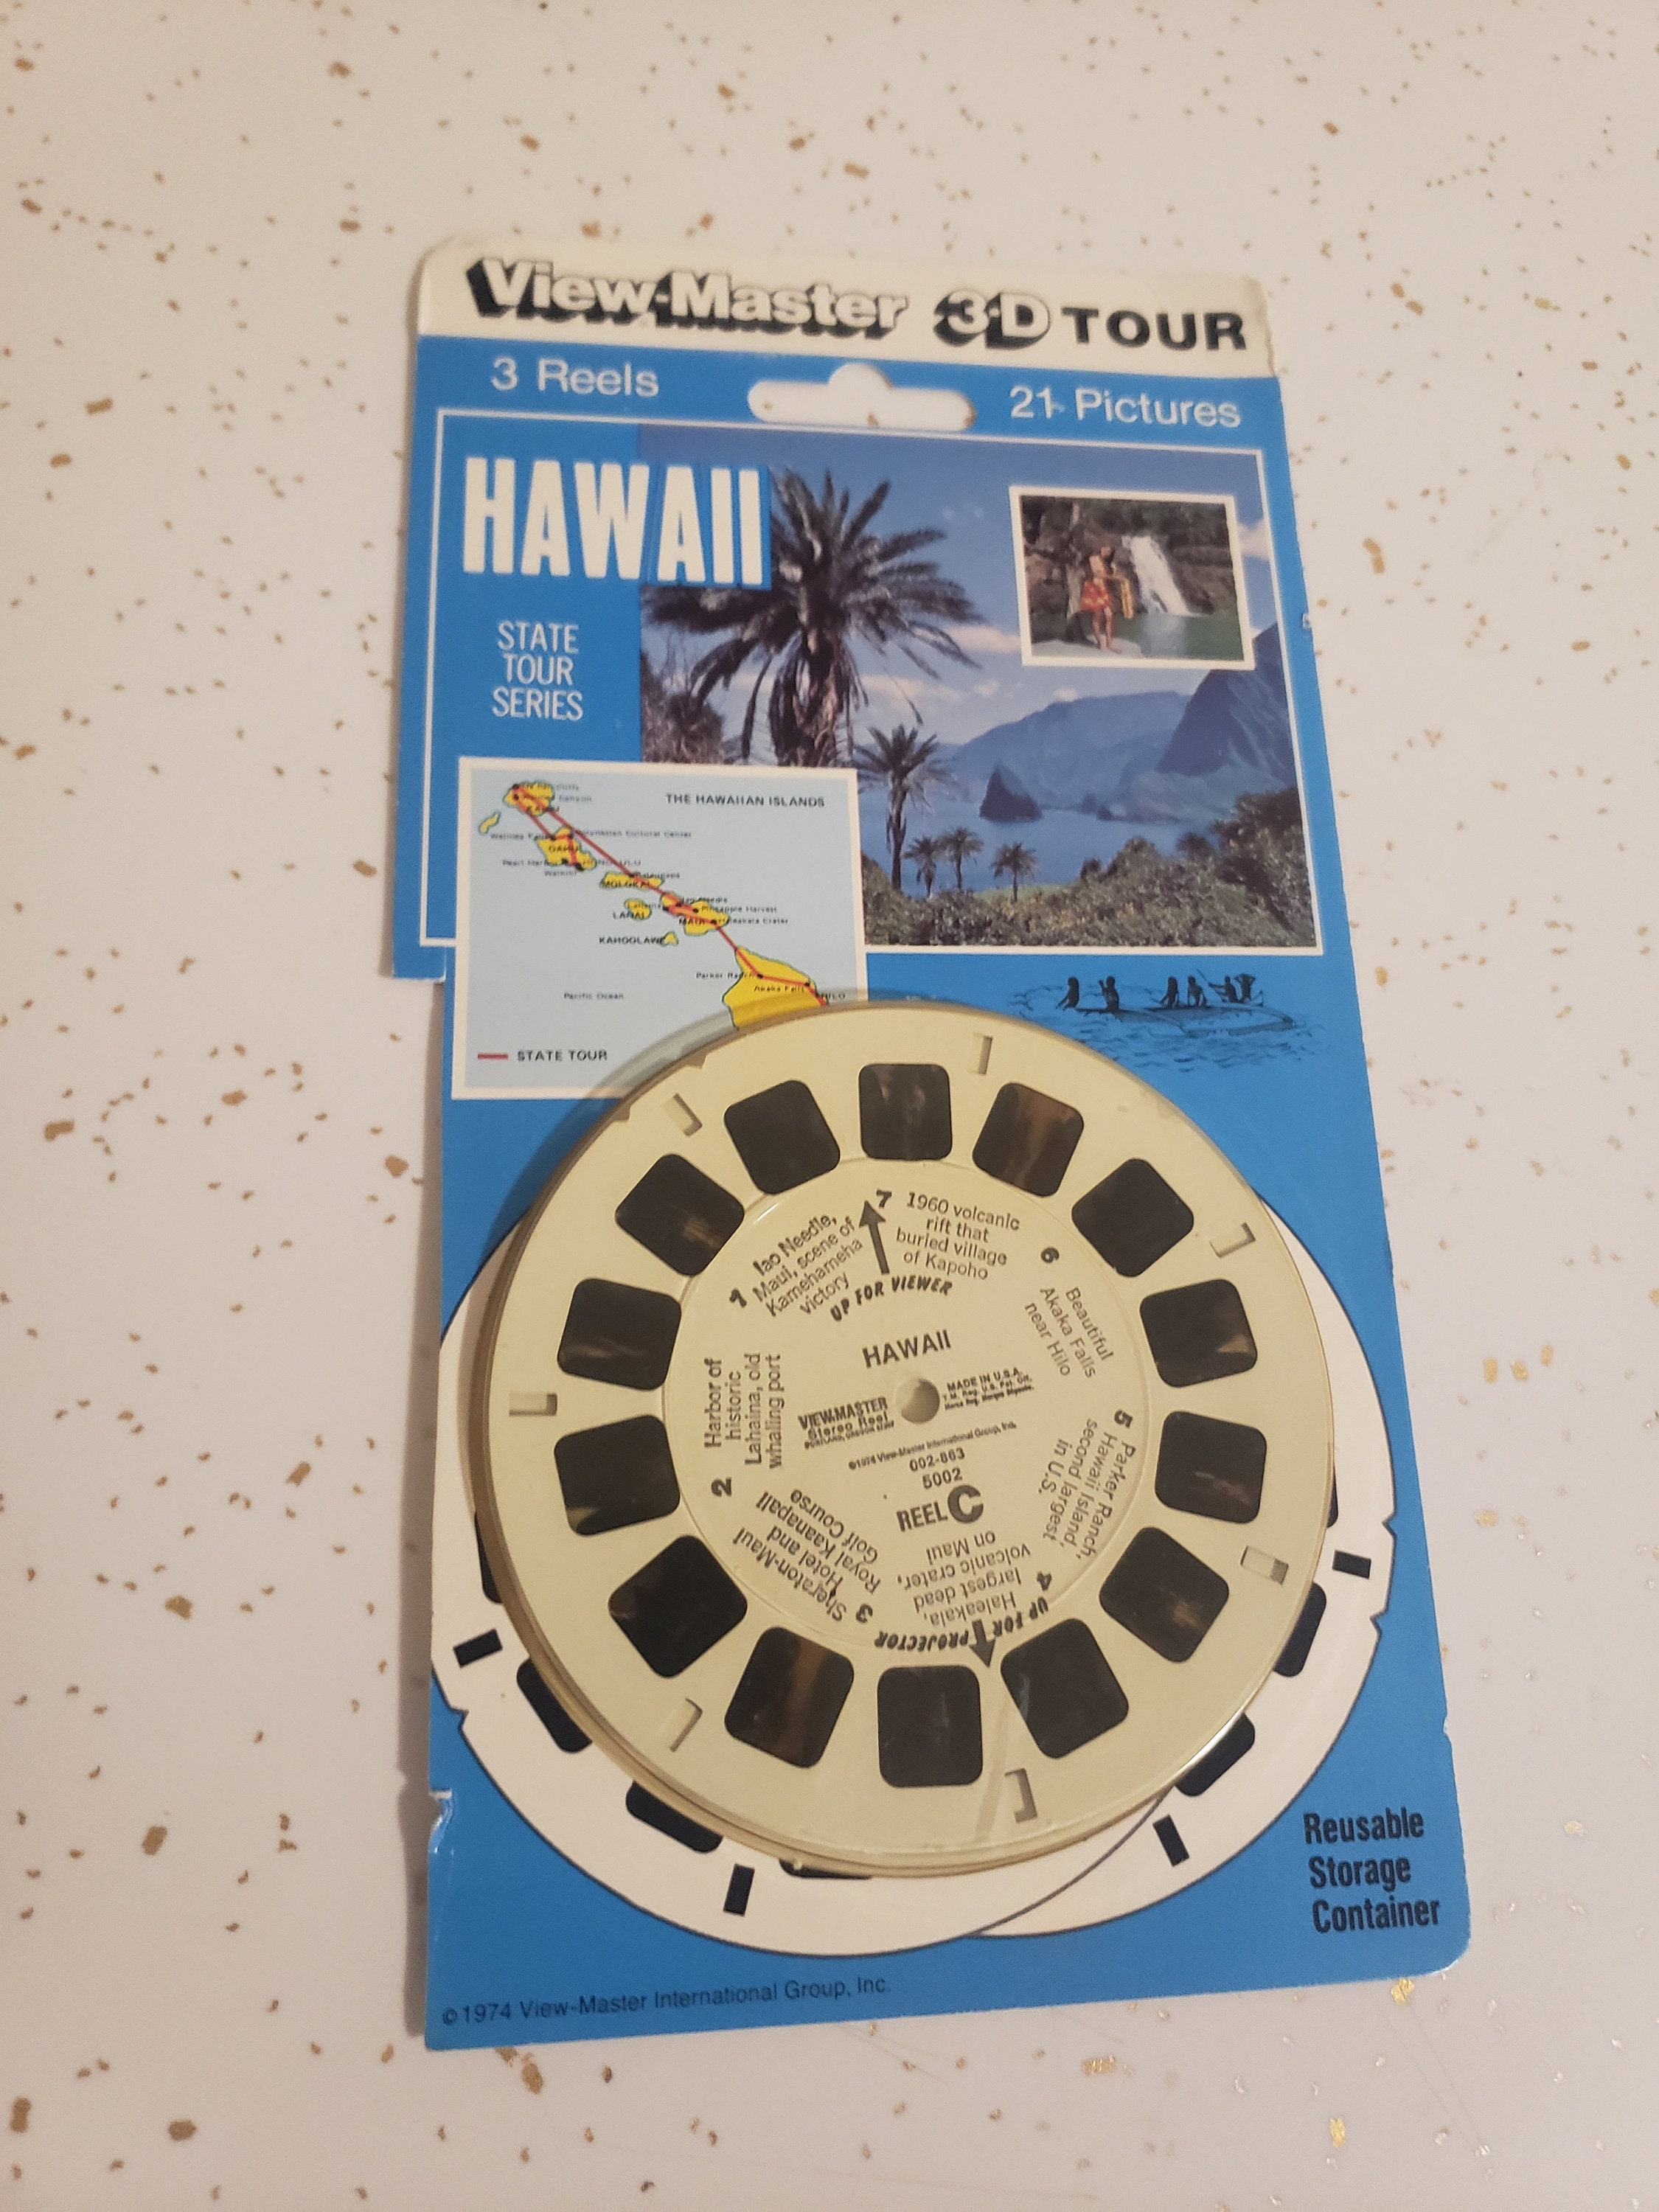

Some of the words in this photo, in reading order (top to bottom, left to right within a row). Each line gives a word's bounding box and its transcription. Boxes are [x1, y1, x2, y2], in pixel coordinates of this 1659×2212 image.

[466, 258, 908, 339] View-Master
[1060, 307, 1247, 351] TOUR
[493, 358, 518, 390] 3
[538, 358, 658, 397] Reels
[1010, 385, 1056, 419] 21
[1074, 388, 1241, 428] Pictures
[463, 457, 762, 585] HAWAII
[497, 620, 579, 654] STATE
[503, 653, 574, 686] TOUR
[492, 686, 583, 721] SERIES
[666, 793, 691, 804] THE
[695, 794, 764, 806] HAWAIIAN
[769, 796, 825, 807] ISLANDS
[517, 1049, 563, 1061] STATE
[569, 1050, 608, 1061] TOUR
[876, 1189, 892, 1208] 7
[906, 1191, 949, 1214] 1960
[953, 1206, 1020, 1231] volcanic
[753, 1253, 781, 1276] Iao
[778, 1214, 838, 1257] Needle,
[896, 1226, 948, 1253] buried
[953, 1241, 1007, 1267] village
[926, 1217, 951, 1235] rift
[956, 1222, 989, 1243] that
[752, 1265, 798, 1303] Maui,
[796, 1232, 838, 1270] scene
[839, 1215, 855, 1238] of
[903, 1251, 920, 1265] of
[925, 1252, 988, 1281] Kapoho
[1040, 1247, 1060, 1264] 6
[765, 1238, 863, 1318] Kamehameha
[799, 1271, 849, 1315] victory
[729, 1287, 747, 1308] 1
[830, 1298, 850, 1322] UP
[855, 1281, 885, 1305] FOR
[891, 1274, 953, 1295] VIEWER
[1024, 1302, 1052, 1339] near
[1047, 1340, 1071, 1377] Hilo
[1040, 1287, 1073, 1337] Akaka
[1070, 1337, 1096, 1379] Falls
[1065, 1286, 1114, 1361] Beautiful
[704, 1357, 722, 1378] of
[744, 1352, 761, 1381] old
[862, 1329, 952, 1369] HAWAII
[765, 1353, 785, 1392] port
[947, 1376, 977, 1392] MADE
[979, 1373, 992, 1384] IN
[704, 1382, 722, 1448] Harbor
[725, 1371, 742, 1441] historic
[858, 1412, 889, 1431] Reel
[1114, 1408, 1133, 1429] 5
[744, 1385, 763, 1465] Lahaina,
[765, 1396, 785, 1470] whaling
[908, 1447, 965, 1472] 002-863
[1054, 1439, 1073, 1457] in
[1068, 1419, 1097, 1480] second
[1085, 1431, 1118, 1492] Hawaii
[711, 1477, 732, 1498] 2
[922, 1467, 963, 1489] 5002
[1038, 1460, 1065, 1495] U.S.
[1105, 1441, 1137, 1501] Parker
[756, 1491, 836, 1560] Kaanapali
[790, 1489, 845, 1539] Course
[897, 1501, 948, 1532] REEL
[947, 1485, 984, 1524] C
[1043, 1481, 1078, 1542] largest
[1060, 1492, 1095, 1548] Island,
[766, 1525, 800, 1557] and
[841, 1531, 878, 1565] Golf
[926, 1537, 970, 1565] Maui
[974, 1530, 995, 1548] on
[732, 1527, 847, 1621] Sheraton-Maui
[798, 1550, 844, 1590] Hotel
[834, 1551, 881, 1595] Royal
[897, 1564, 955, 1590] crater,
[960, 1543, 1031, 1576] volcanic
[913, 1586, 956, 1613] dead
[960, 1568, 1021, 1599] largest
[1036, 1571, 1052, 1591] 4
[855, 1603, 873, 1624] 3
[923, 1591, 1016, 1628] Haleakala,
[992, 1612, 1023, 1638] FOR
[1029, 1596, 1048, 1620] UP
[874, 1630, 969, 1652] PROJECTOR
[1304, 1806, 1424, 1844] Reusable
[1308, 1856, 1411, 1892] Storage
[1312, 1895, 1439, 1933] Container
[519, 1994, 647, 2019] View-Master
[655, 1983, 777, 2008] International
[785, 1979, 851, 2000] Group,
[858, 1976, 891, 1994] Inc.
